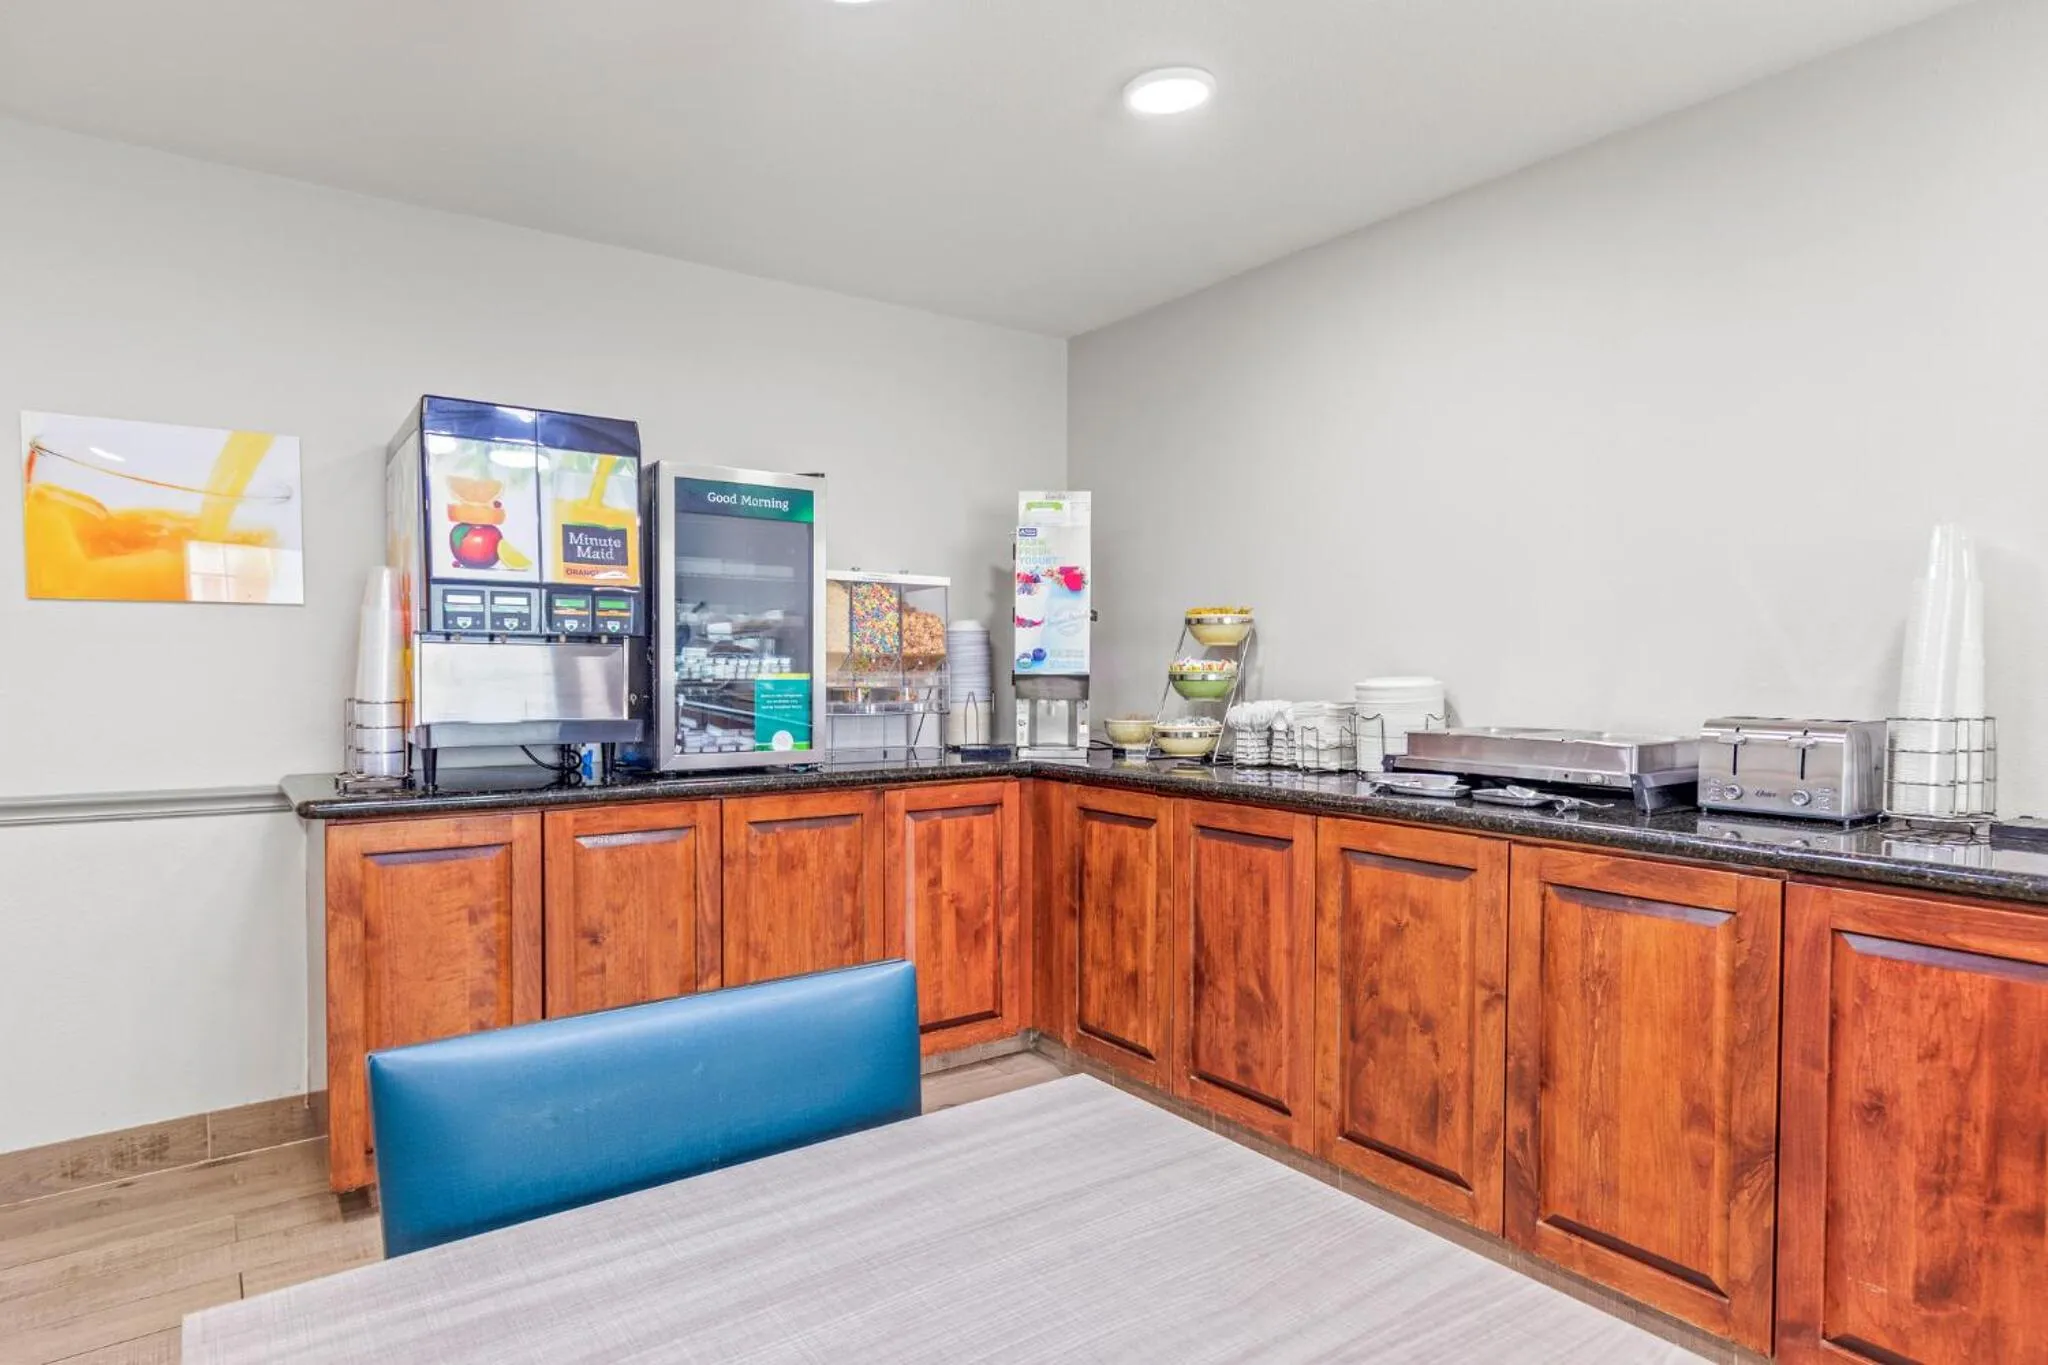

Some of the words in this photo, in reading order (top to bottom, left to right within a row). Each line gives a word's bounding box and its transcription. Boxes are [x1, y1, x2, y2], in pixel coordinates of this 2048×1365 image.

[707, 492, 737, 505] Good
[741, 495, 789, 512] Morning
[568, 532, 621, 548] Minute
[576, 545, 614, 560] Maid
[566, 568, 599, 577] ORANG
